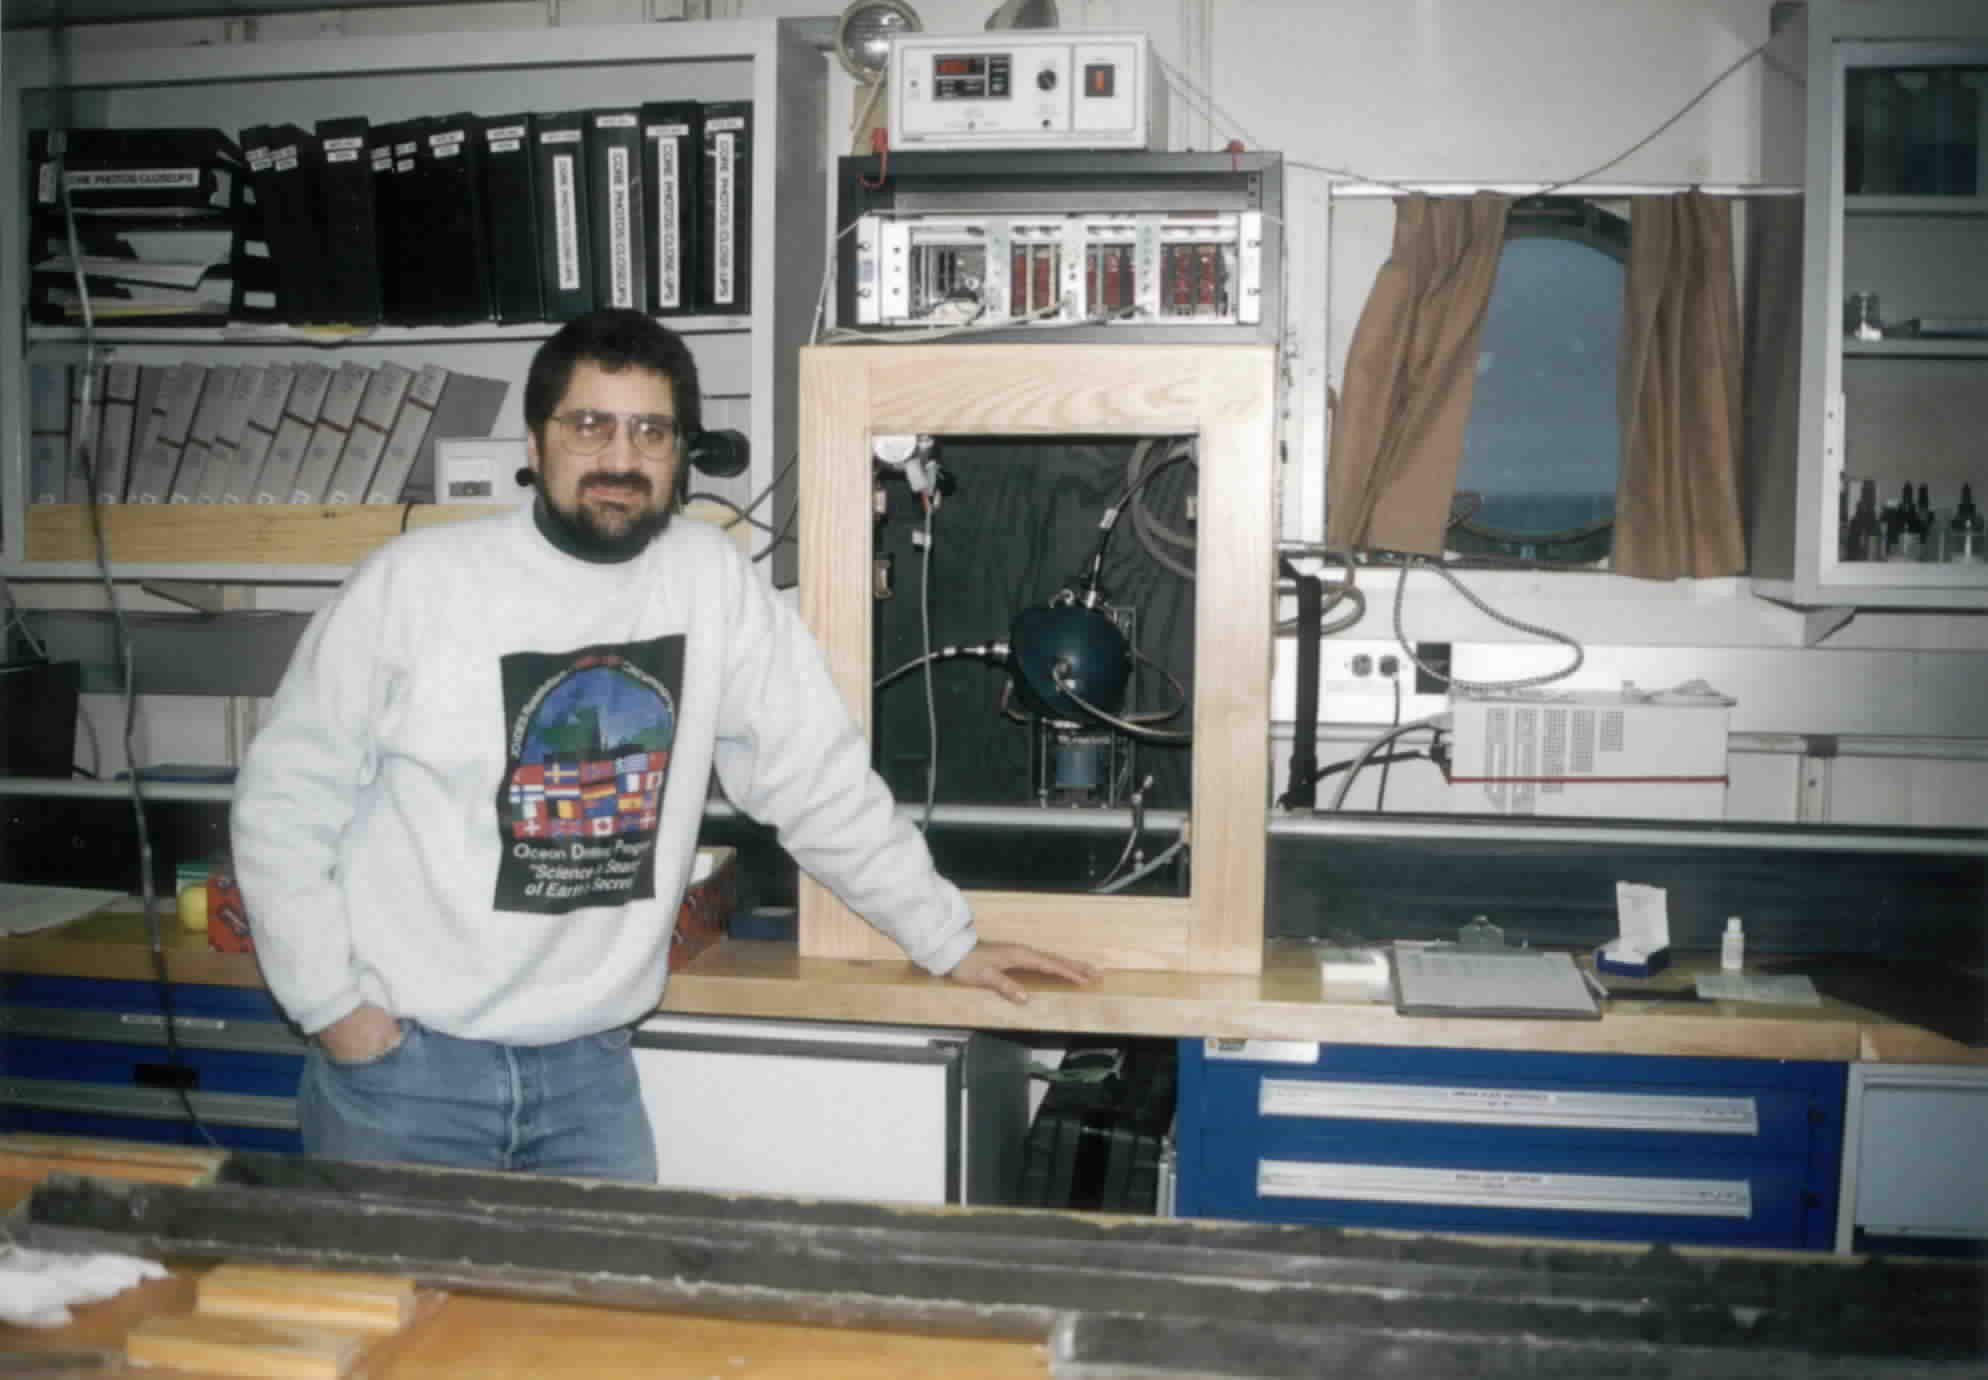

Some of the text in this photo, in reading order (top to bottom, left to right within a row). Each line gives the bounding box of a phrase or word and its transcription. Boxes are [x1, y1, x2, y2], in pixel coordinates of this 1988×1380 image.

[612, 152, 625, 185] CORE
[662, 143, 674, 176] CORE
[719, 139, 729, 172] CORE
[614, 190, 627, 238] PHOTOS
[663, 180, 674, 230] PHOTOS
[719, 177, 729, 225] PHOTOS
[513, 842, 567, 859] Ocean
[524, 880, 544, 896] of
